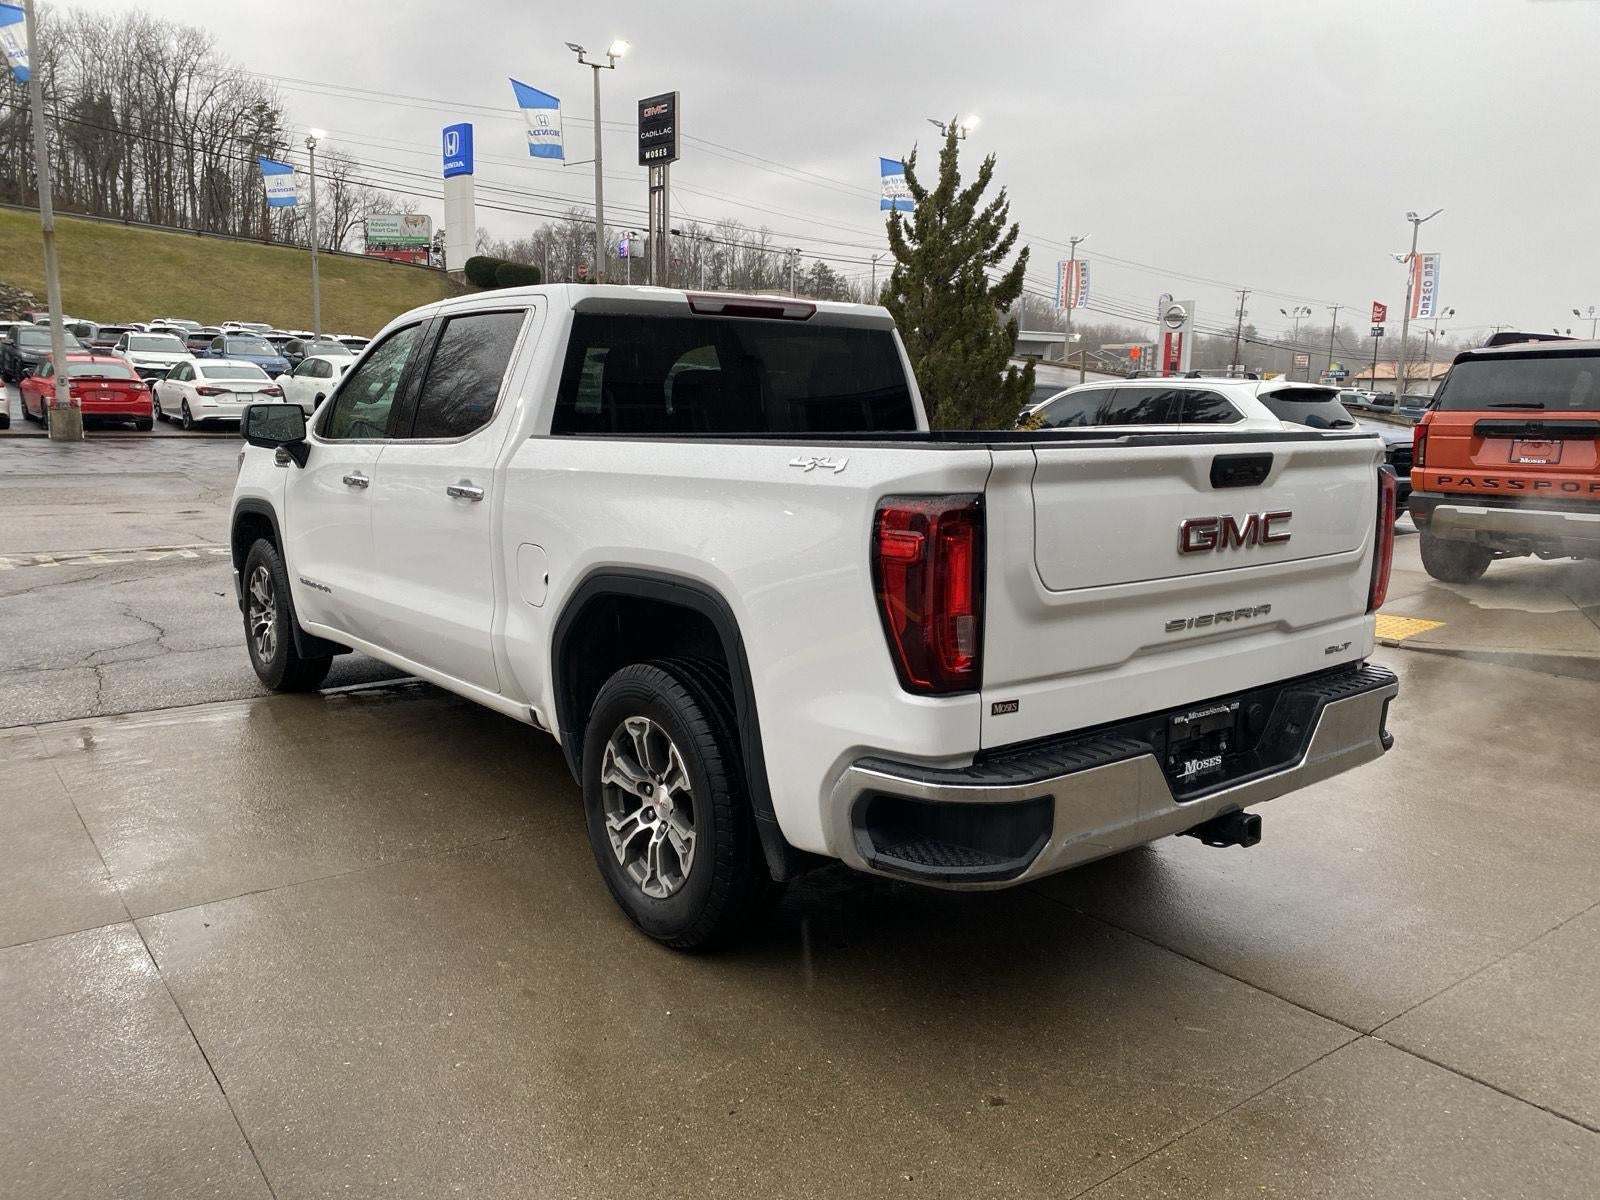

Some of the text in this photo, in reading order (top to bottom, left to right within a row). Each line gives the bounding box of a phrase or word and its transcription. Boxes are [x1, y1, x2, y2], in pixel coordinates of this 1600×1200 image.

[644, 104, 668, 117] GMC
[641, 127, 672, 138] CADILLAC
[645, 148, 667, 159] MOSES
[1078, 280, 1087, 306] OWNED
[1420, 256, 1434, 316] PRE OWNED
[1178, 510, 1293, 555] GMC
[1165, 604, 1272, 633] SIERRA
[1325, 641, 1352, 655] SLT
[993, 703, 1017, 714] MOSES
[1183, 755, 1222, 776] MOSES
